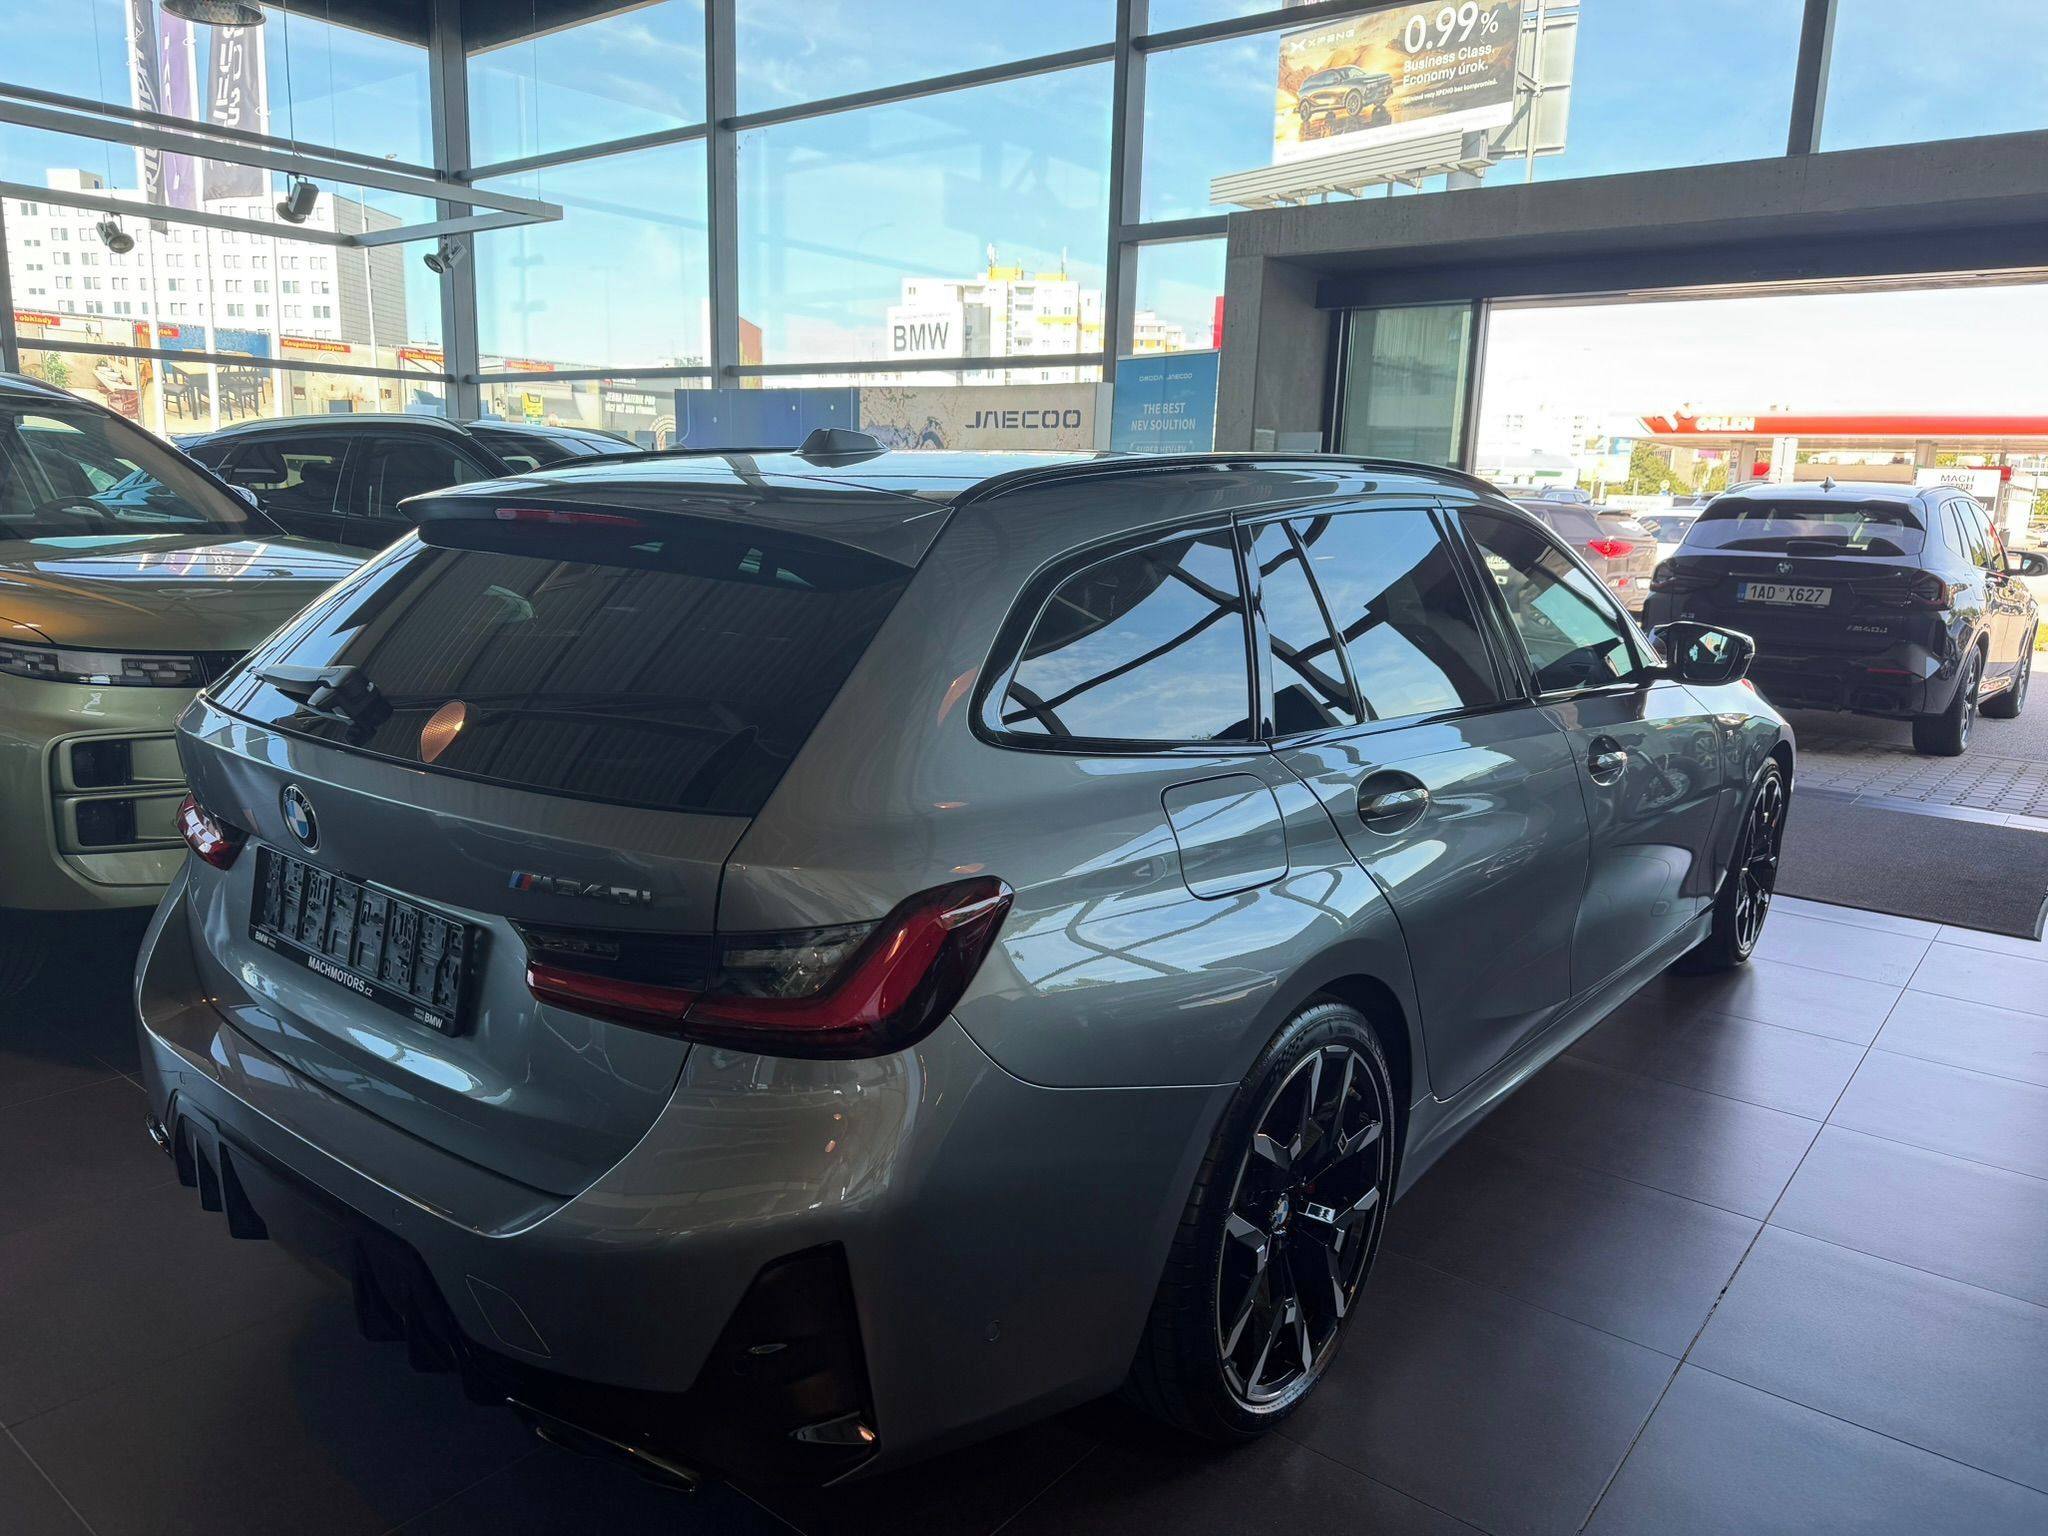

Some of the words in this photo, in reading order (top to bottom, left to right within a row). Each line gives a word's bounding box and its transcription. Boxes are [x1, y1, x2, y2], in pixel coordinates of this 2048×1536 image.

[1308, 29, 1355, 48] XPENG
[1403, 52, 1456, 73] Business
[1458, 44, 1495, 60] Class.
[1403, 66, 1456, 86] Economy
[1458, 59, 1489, 75] úrok.
[893, 321, 949, 352] BMW
[1144, 403, 1161, 415] THE
[1163, 402, 1185, 414] BEST
[965, 410, 1081, 429] JAECOO
[1131, 420, 1149, 432] NEV
[1150, 418, 1196, 431] SOULTION
[1940, 474, 1975, 483] MACH
[1750, 584, 1776, 600] 1AD
[1786, 588, 1825, 603] X627
[254, 930, 269, 945] BMW
[307, 955, 374, 998] MACHMOTORS.cz
[424, 1011, 444, 1029] BMW
